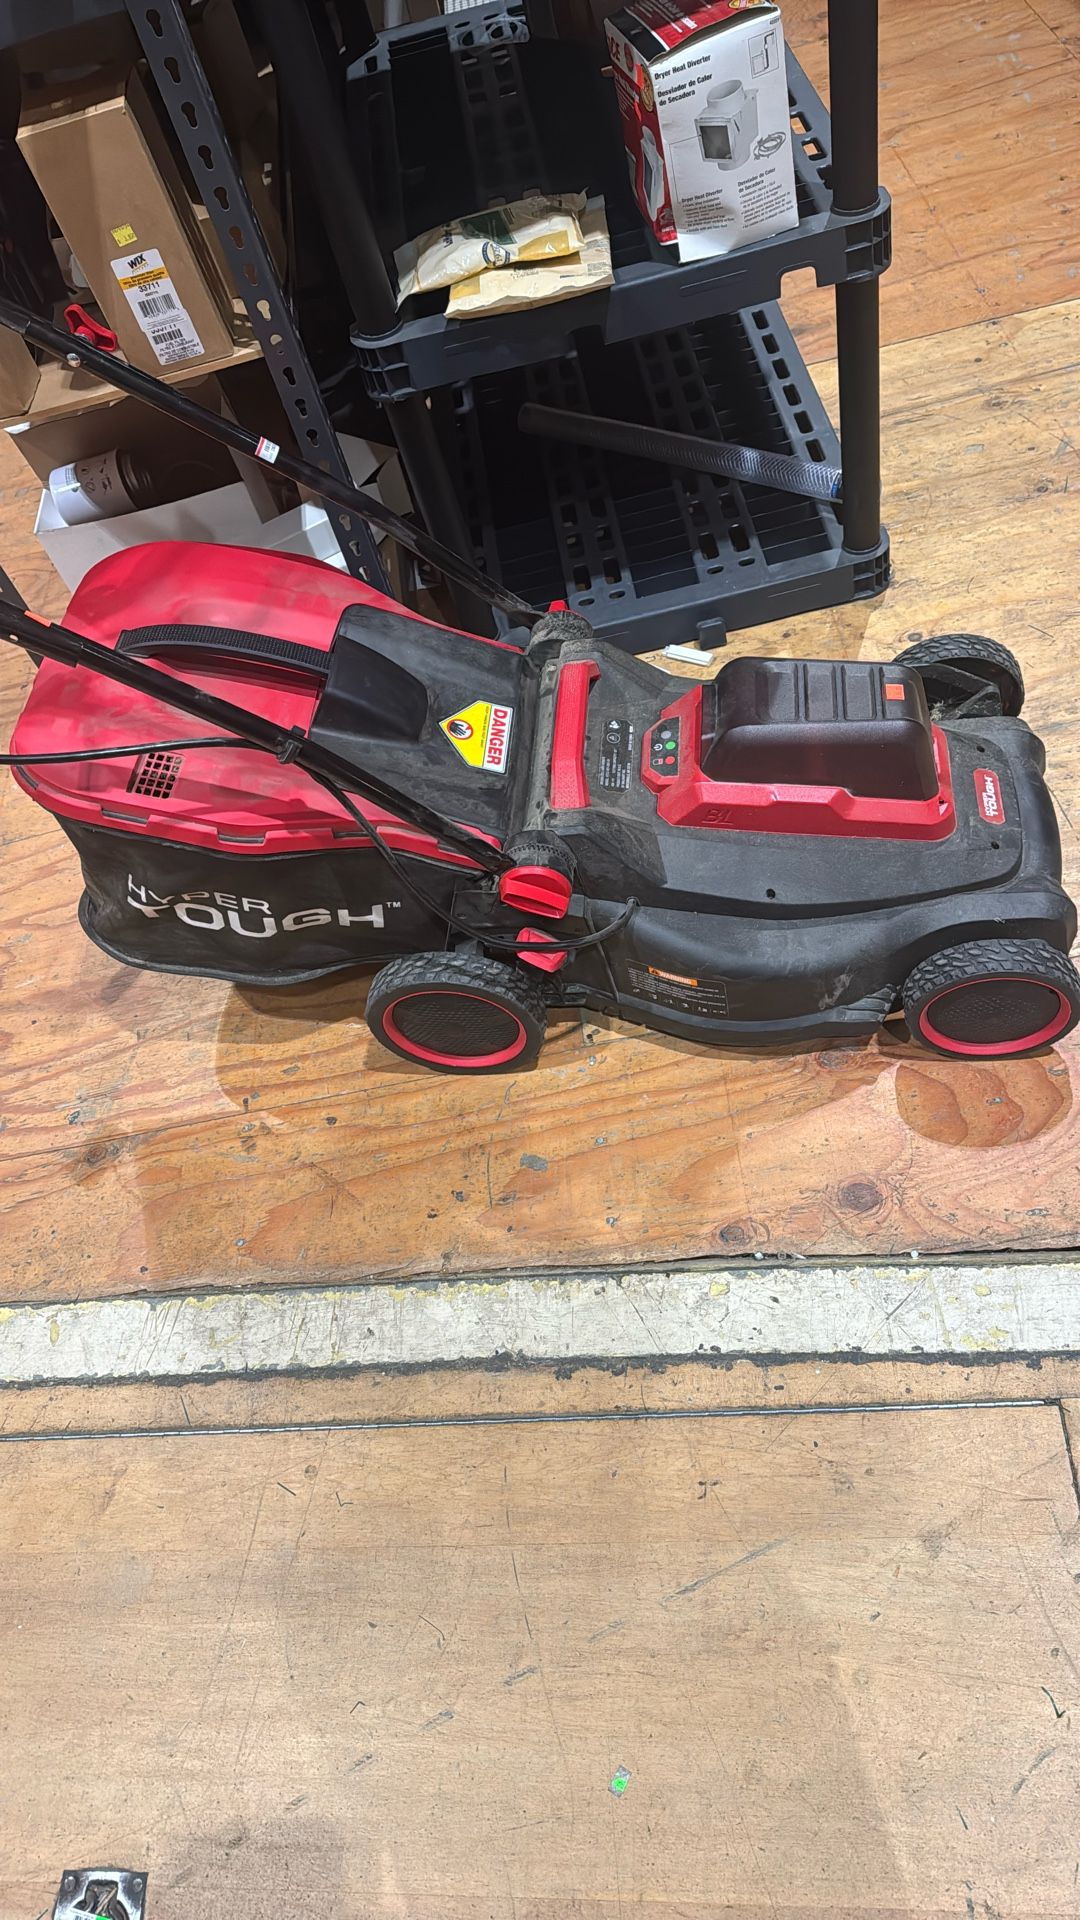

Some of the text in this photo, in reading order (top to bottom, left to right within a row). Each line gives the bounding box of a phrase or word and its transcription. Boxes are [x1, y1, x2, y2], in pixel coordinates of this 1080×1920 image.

[654, 54, 711, 81] Dryer Heat Diverter
[657, 73, 713, 98] Desviador de Calor
[658, 89, 696, 108] de Secadora
[694, 193, 706, 201] Heat
[705, 188, 723, 198] Diverter
[127, 253, 147, 270] WIX
[138, 281, 161, 293] 33711
[487, 707, 508, 766] DANGER
[984, 774, 998, 816] TOUGH
[128, 873, 273, 915] HYPER
[127, 895, 385, 938] TOUGH
[659, 970, 691, 986] WARNING
